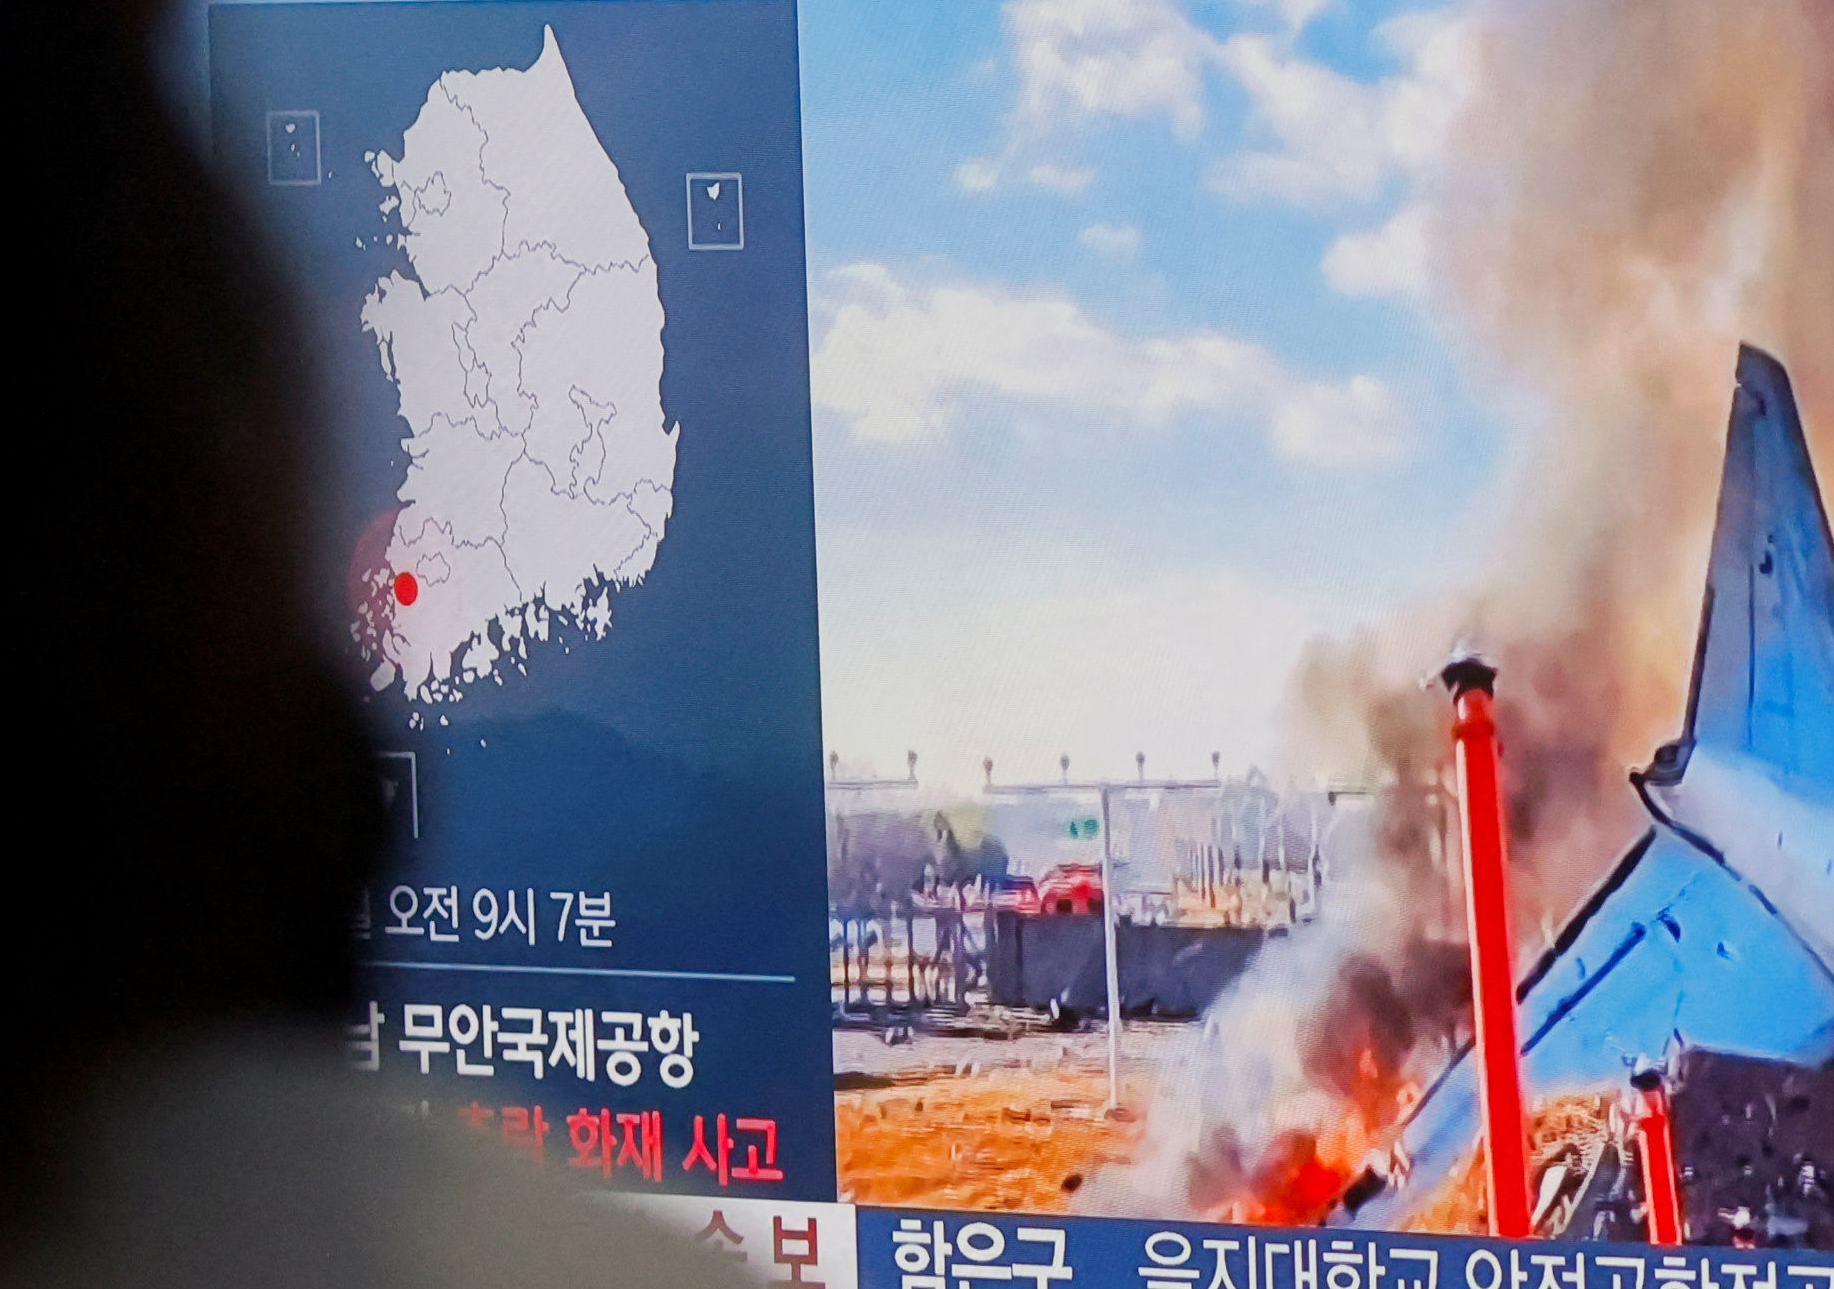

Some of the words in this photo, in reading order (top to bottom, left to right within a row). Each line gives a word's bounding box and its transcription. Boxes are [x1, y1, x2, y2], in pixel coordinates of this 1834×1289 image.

[385, 885, 460, 942] 오전
[472, 887, 535, 945] 9시
[549, 890, 616, 948] 7분
[399, 1003, 699, 1088] 무안국제공항
[567, 1107, 662, 1182] 화재
[683, 1112, 783, 1186] 사고
